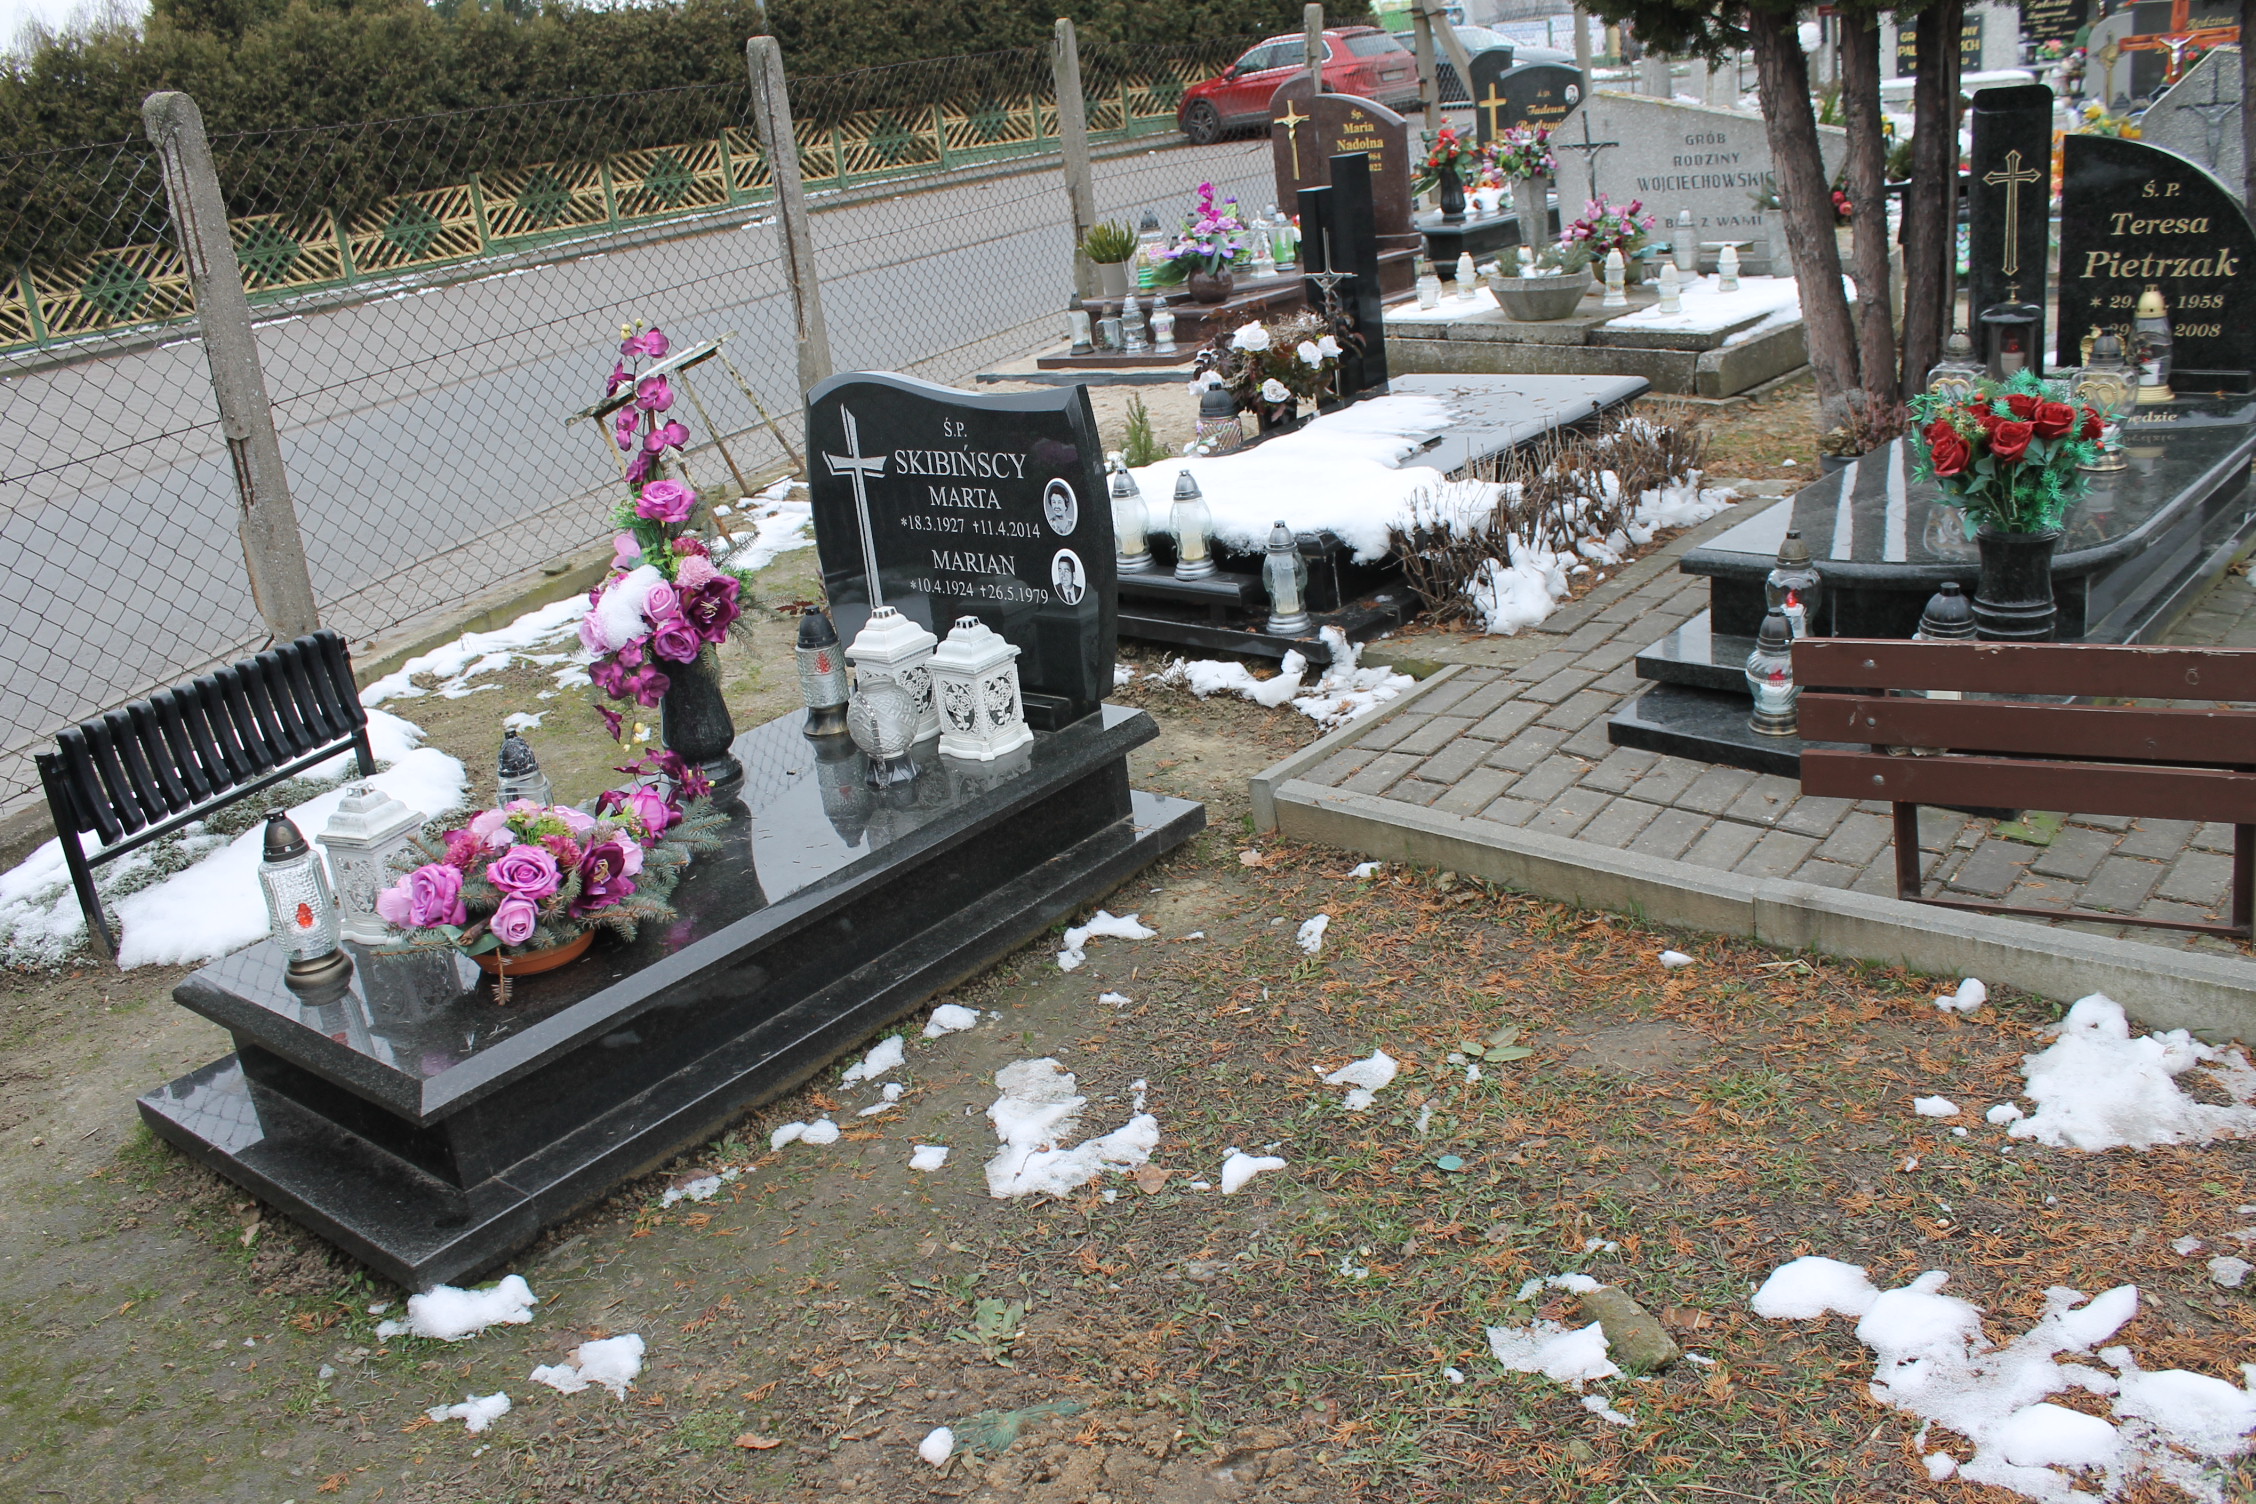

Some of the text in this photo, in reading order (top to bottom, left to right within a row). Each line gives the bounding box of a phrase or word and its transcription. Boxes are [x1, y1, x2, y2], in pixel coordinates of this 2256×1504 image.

[1342, 121, 1375, 134] Maria
[1336, 136, 1384, 152] Nadolna
[1685, 131, 1726, 146] GRÓB
[1673, 152, 1741, 167] RODZINY
[1701, 217, 1710, 227] Z
[1716, 215, 1763, 226] WAMI
[2109, 211, 2210, 236] Teresa
[2078, 247, 2240, 279] Pietrzak
[2176, 294, 2225, 309] 1958
[2174, 323, 2222, 337] 2008
[942, 417, 968, 438] Ś.P.
[894, 444, 1028, 480] SKIBIŃSCY
[928, 485, 1002, 510] MARTA
[931, 549, 1016, 577] MARIAN
